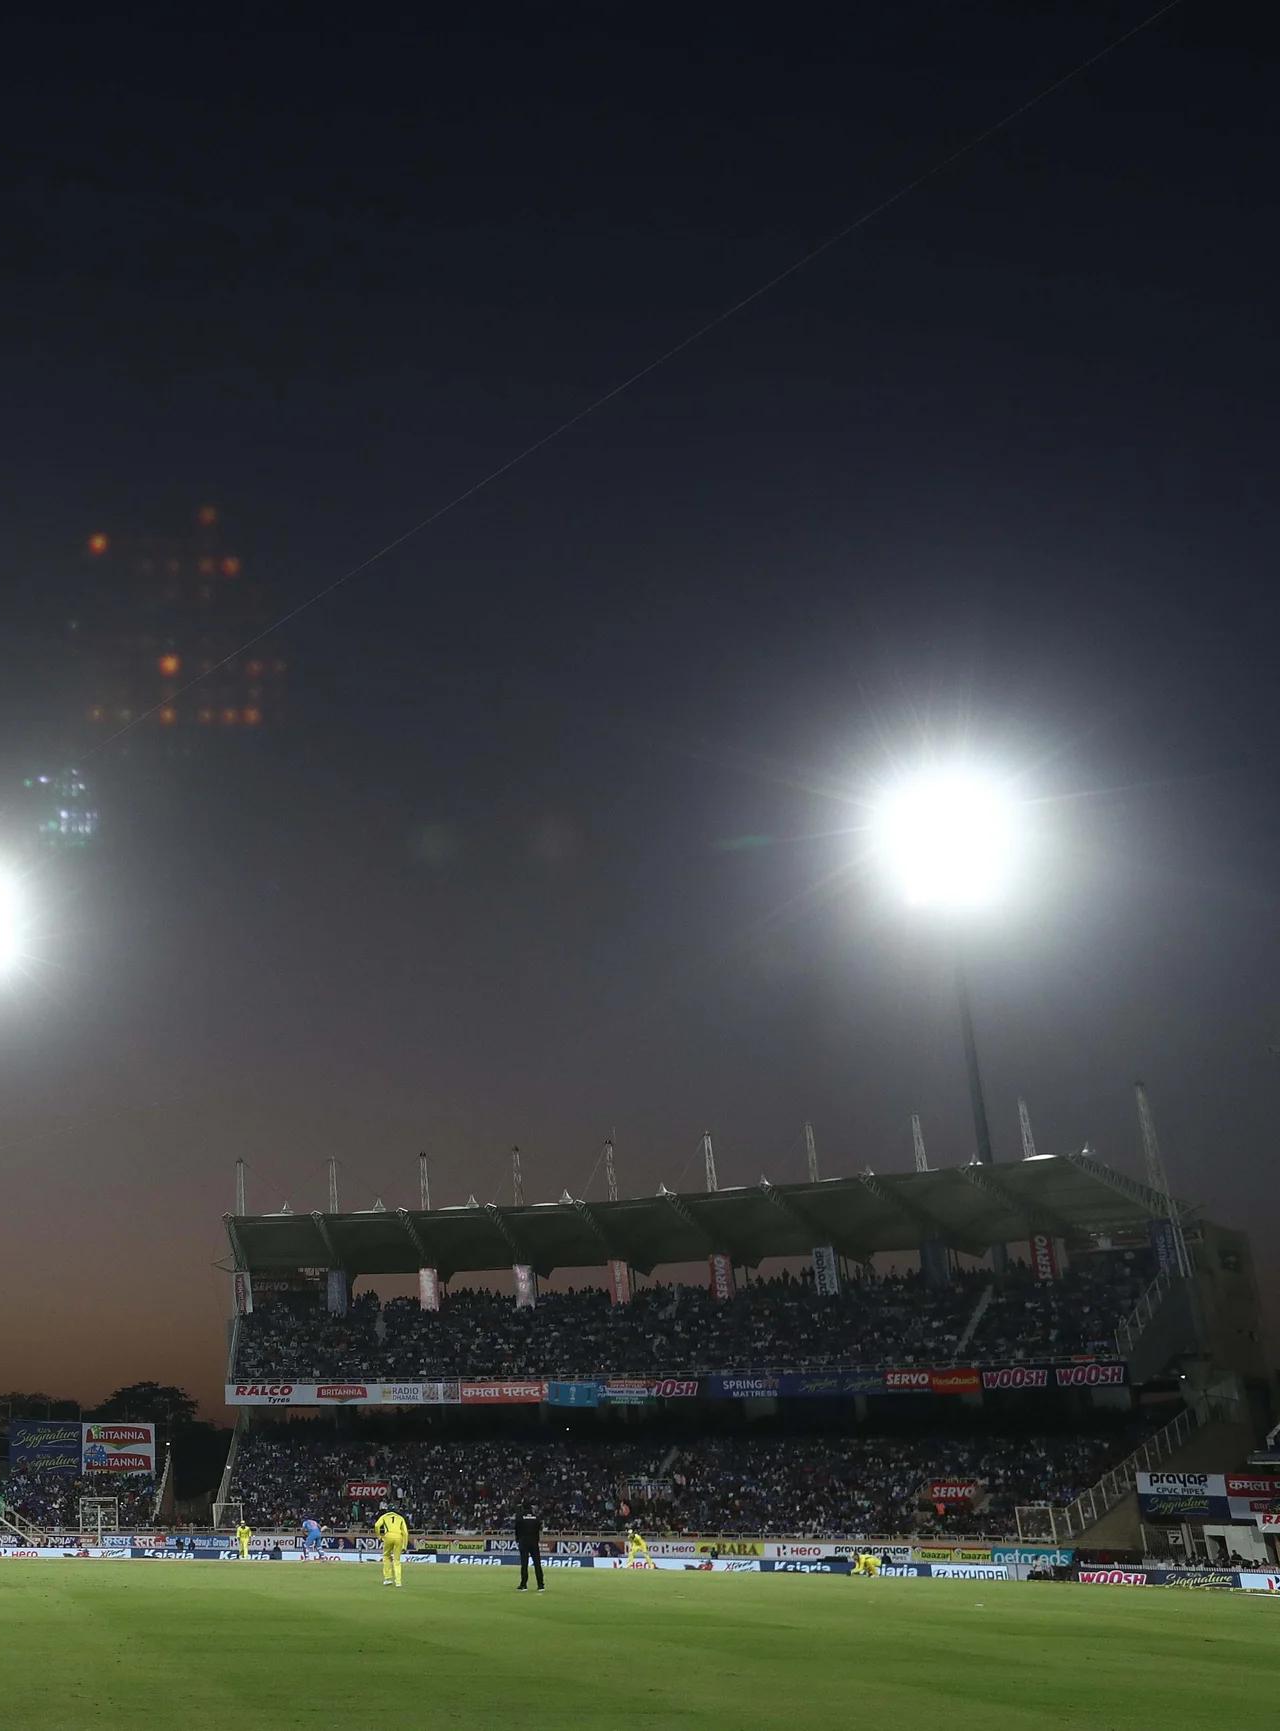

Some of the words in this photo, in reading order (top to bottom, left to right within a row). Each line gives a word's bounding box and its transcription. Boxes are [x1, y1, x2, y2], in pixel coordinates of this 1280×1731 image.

[1034, 1235, 1053, 1281] SERVO
[713, 1254, 729, 1299] SERVO
[886, 1373, 929, 1385] SERVO
[982, 1367, 1048, 1389] WOOSH
[1056, 1364, 1124, 1386] WOOSH
[235, 1385, 293, 1396] RALCO
[321, 1388, 362, 1396] BRITANNIA
[392, 1386, 419, 1396] RADIO
[462, 1387, 499, 1399] कमला
[267, 1396, 290, 1404] Tyres
[93, 1431, 145, 1440] BRITANNIA
[349, 1486, 387, 1497] SERVO
[932, 1486, 975, 1498] SERVO
[1181, 1487, 1205, 1496] PIPES
[490, 1540, 520, 1551] INDIA
[557, 1541, 593, 1554] INDIA
[672, 1545, 695, 1553] Hero
[791, 1546, 821, 1556] Hero
[219, 1550, 270, 1560] Kaaria
[921, 1549, 950, 1559] baazar
[961, 1550, 990, 1560] baazar
[994, 1549, 1070, 1567] netmeds
[449, 1555, 502, 1566] Kajaria
[877, 1563, 918, 1577] jaria
[952, 1569, 1008, 1580] HYUNDAI
[1079, 1569, 1147, 1585] WOOSH
